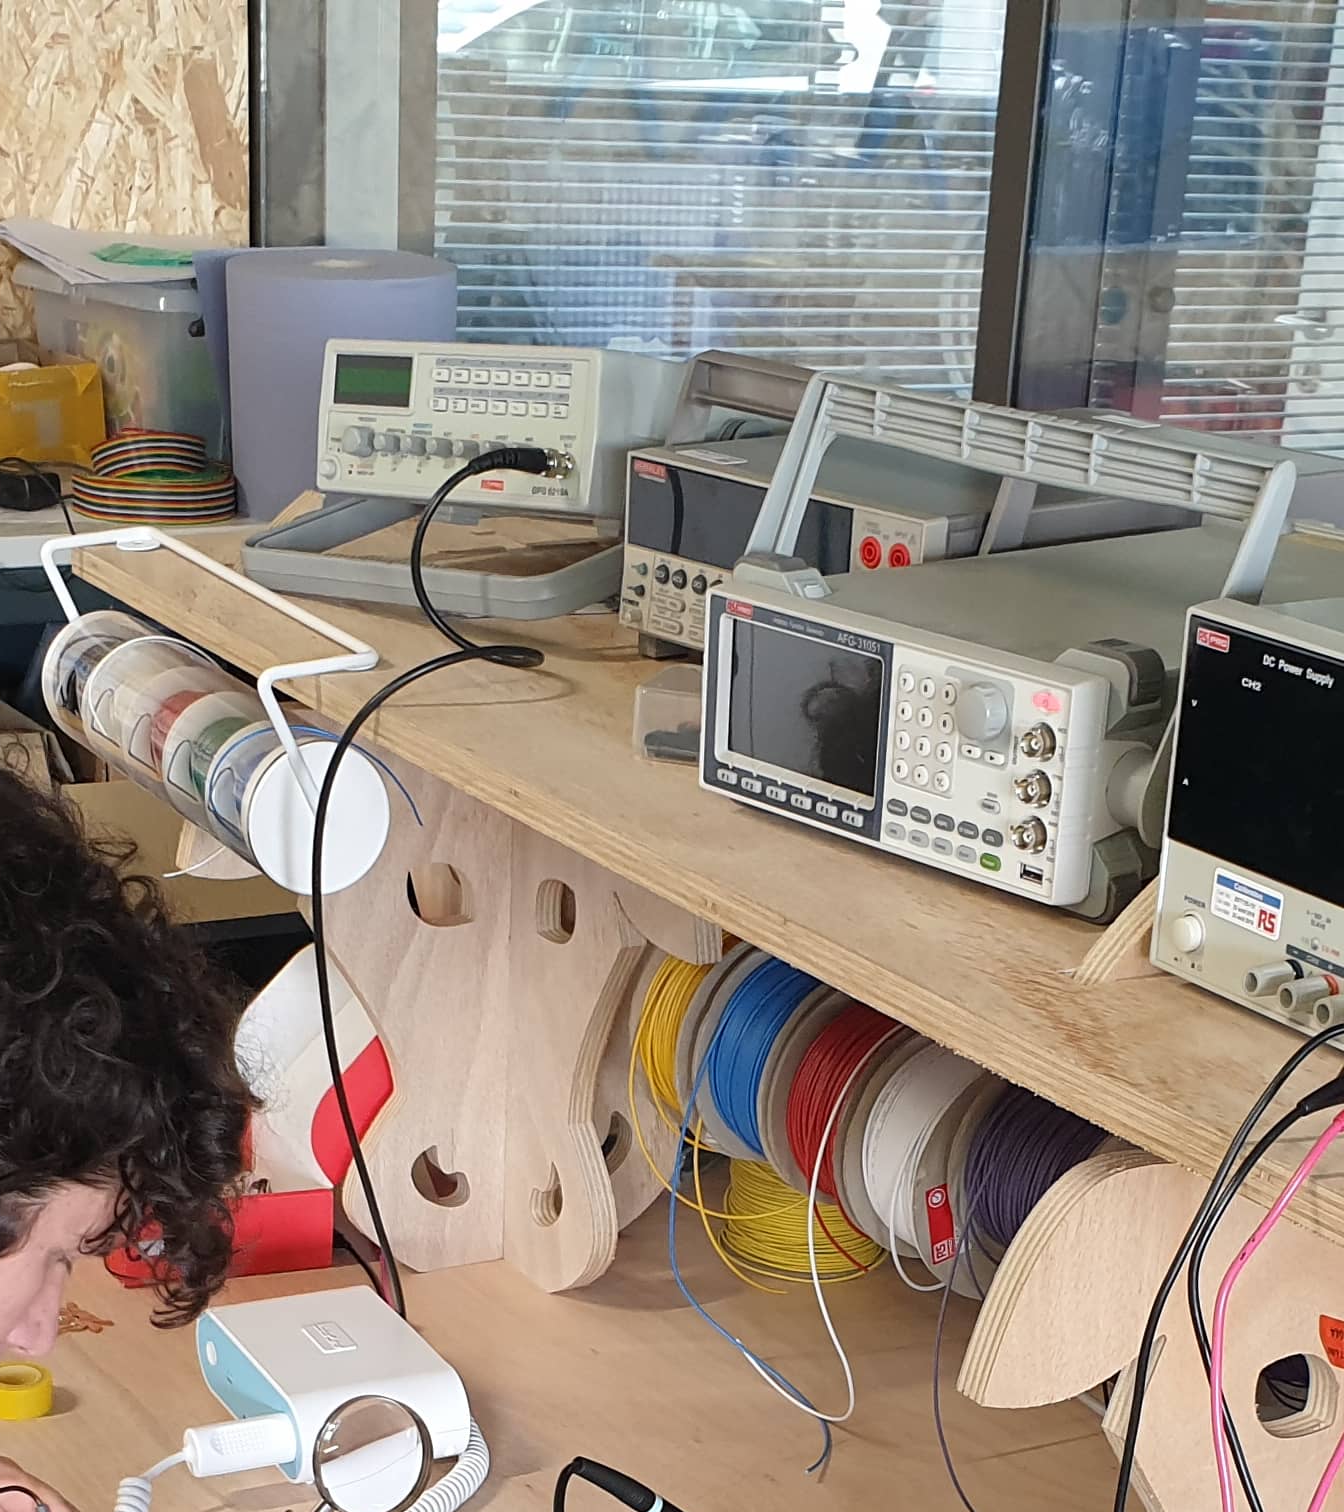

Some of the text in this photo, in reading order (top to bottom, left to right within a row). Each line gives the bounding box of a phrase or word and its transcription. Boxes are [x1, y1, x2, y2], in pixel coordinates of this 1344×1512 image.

[1262, 653, 1335, 690] DC Power Supply
[1241, 676, 1262, 693] CH2
[1184, 894, 1206, 909] POWER
[1257, 908, 1276, 934] RS
